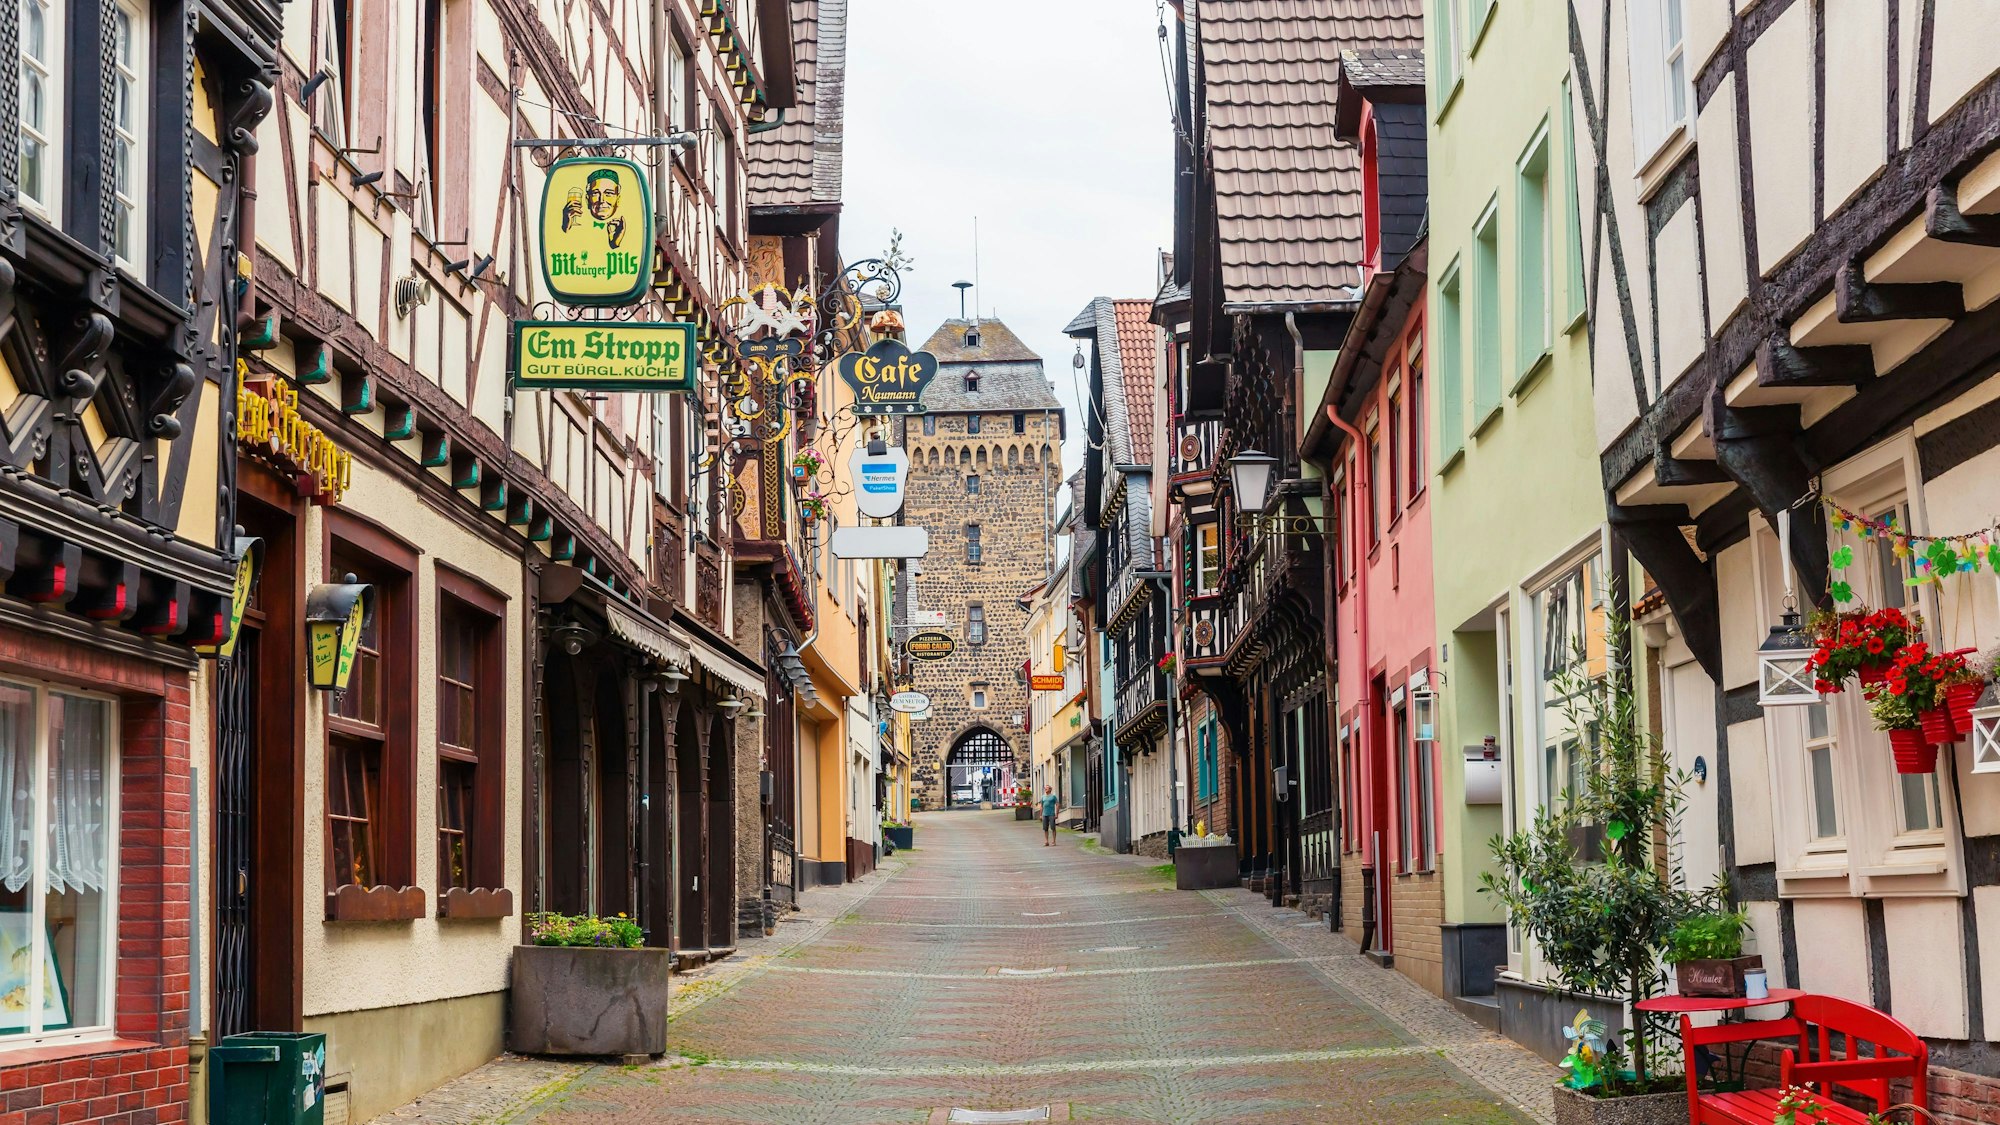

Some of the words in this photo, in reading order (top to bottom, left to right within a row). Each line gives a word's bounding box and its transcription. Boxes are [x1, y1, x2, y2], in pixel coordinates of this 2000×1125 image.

[606, 252, 639, 280] Pils
[527, 330, 577, 359] Em
[581, 330, 680, 367] Stropp
[527, 364, 561, 375] GUT
[564, 363, 622, 376] BÜRGL.
[624, 365, 678, 378] KÜCHE
[854, 355, 923, 390] Cafe
[861, 383, 917, 403] Naumann
[931, 642, 951, 650] CALDO
[1031, 676, 1064, 684] SCHMIDT
